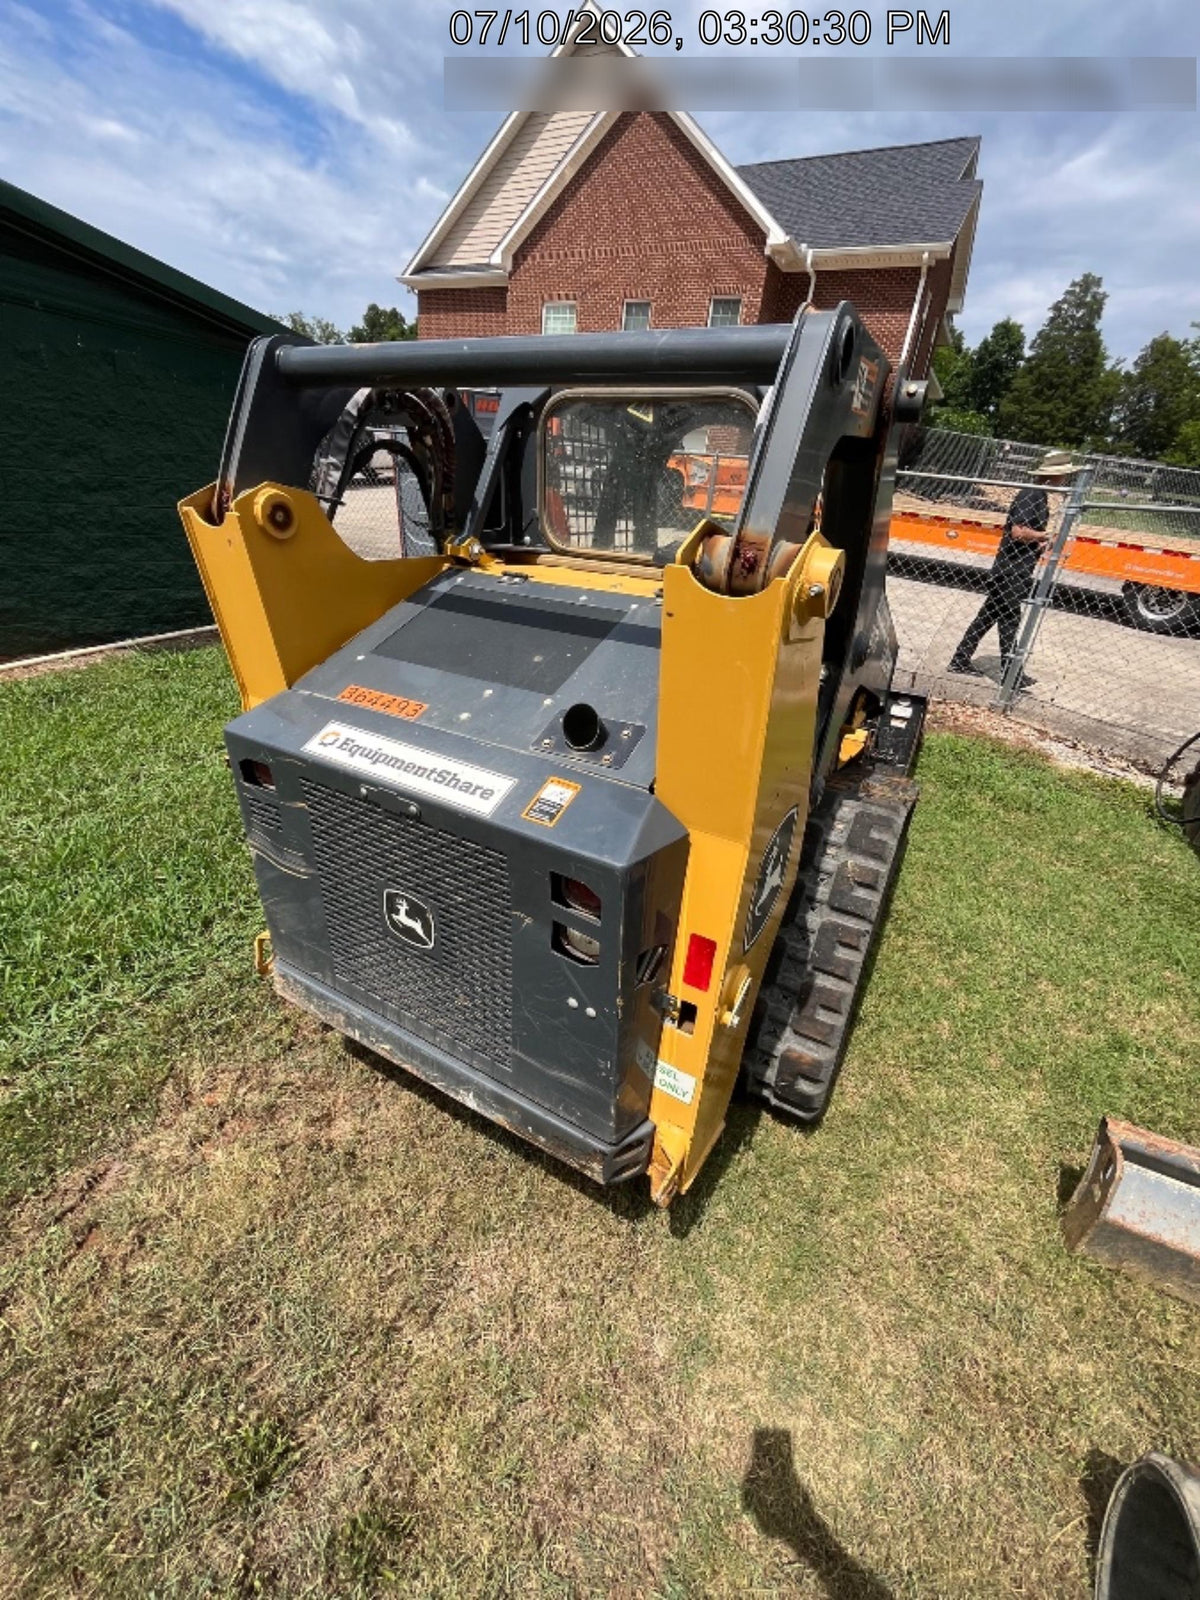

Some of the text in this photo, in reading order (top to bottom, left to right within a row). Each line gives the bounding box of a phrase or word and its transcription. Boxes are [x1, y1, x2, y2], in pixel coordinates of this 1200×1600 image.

[336, 737, 496, 801] EquipmentShare
[657, 1064, 679, 1082] SEL
[659, 1078, 689, 1098] ONLY
